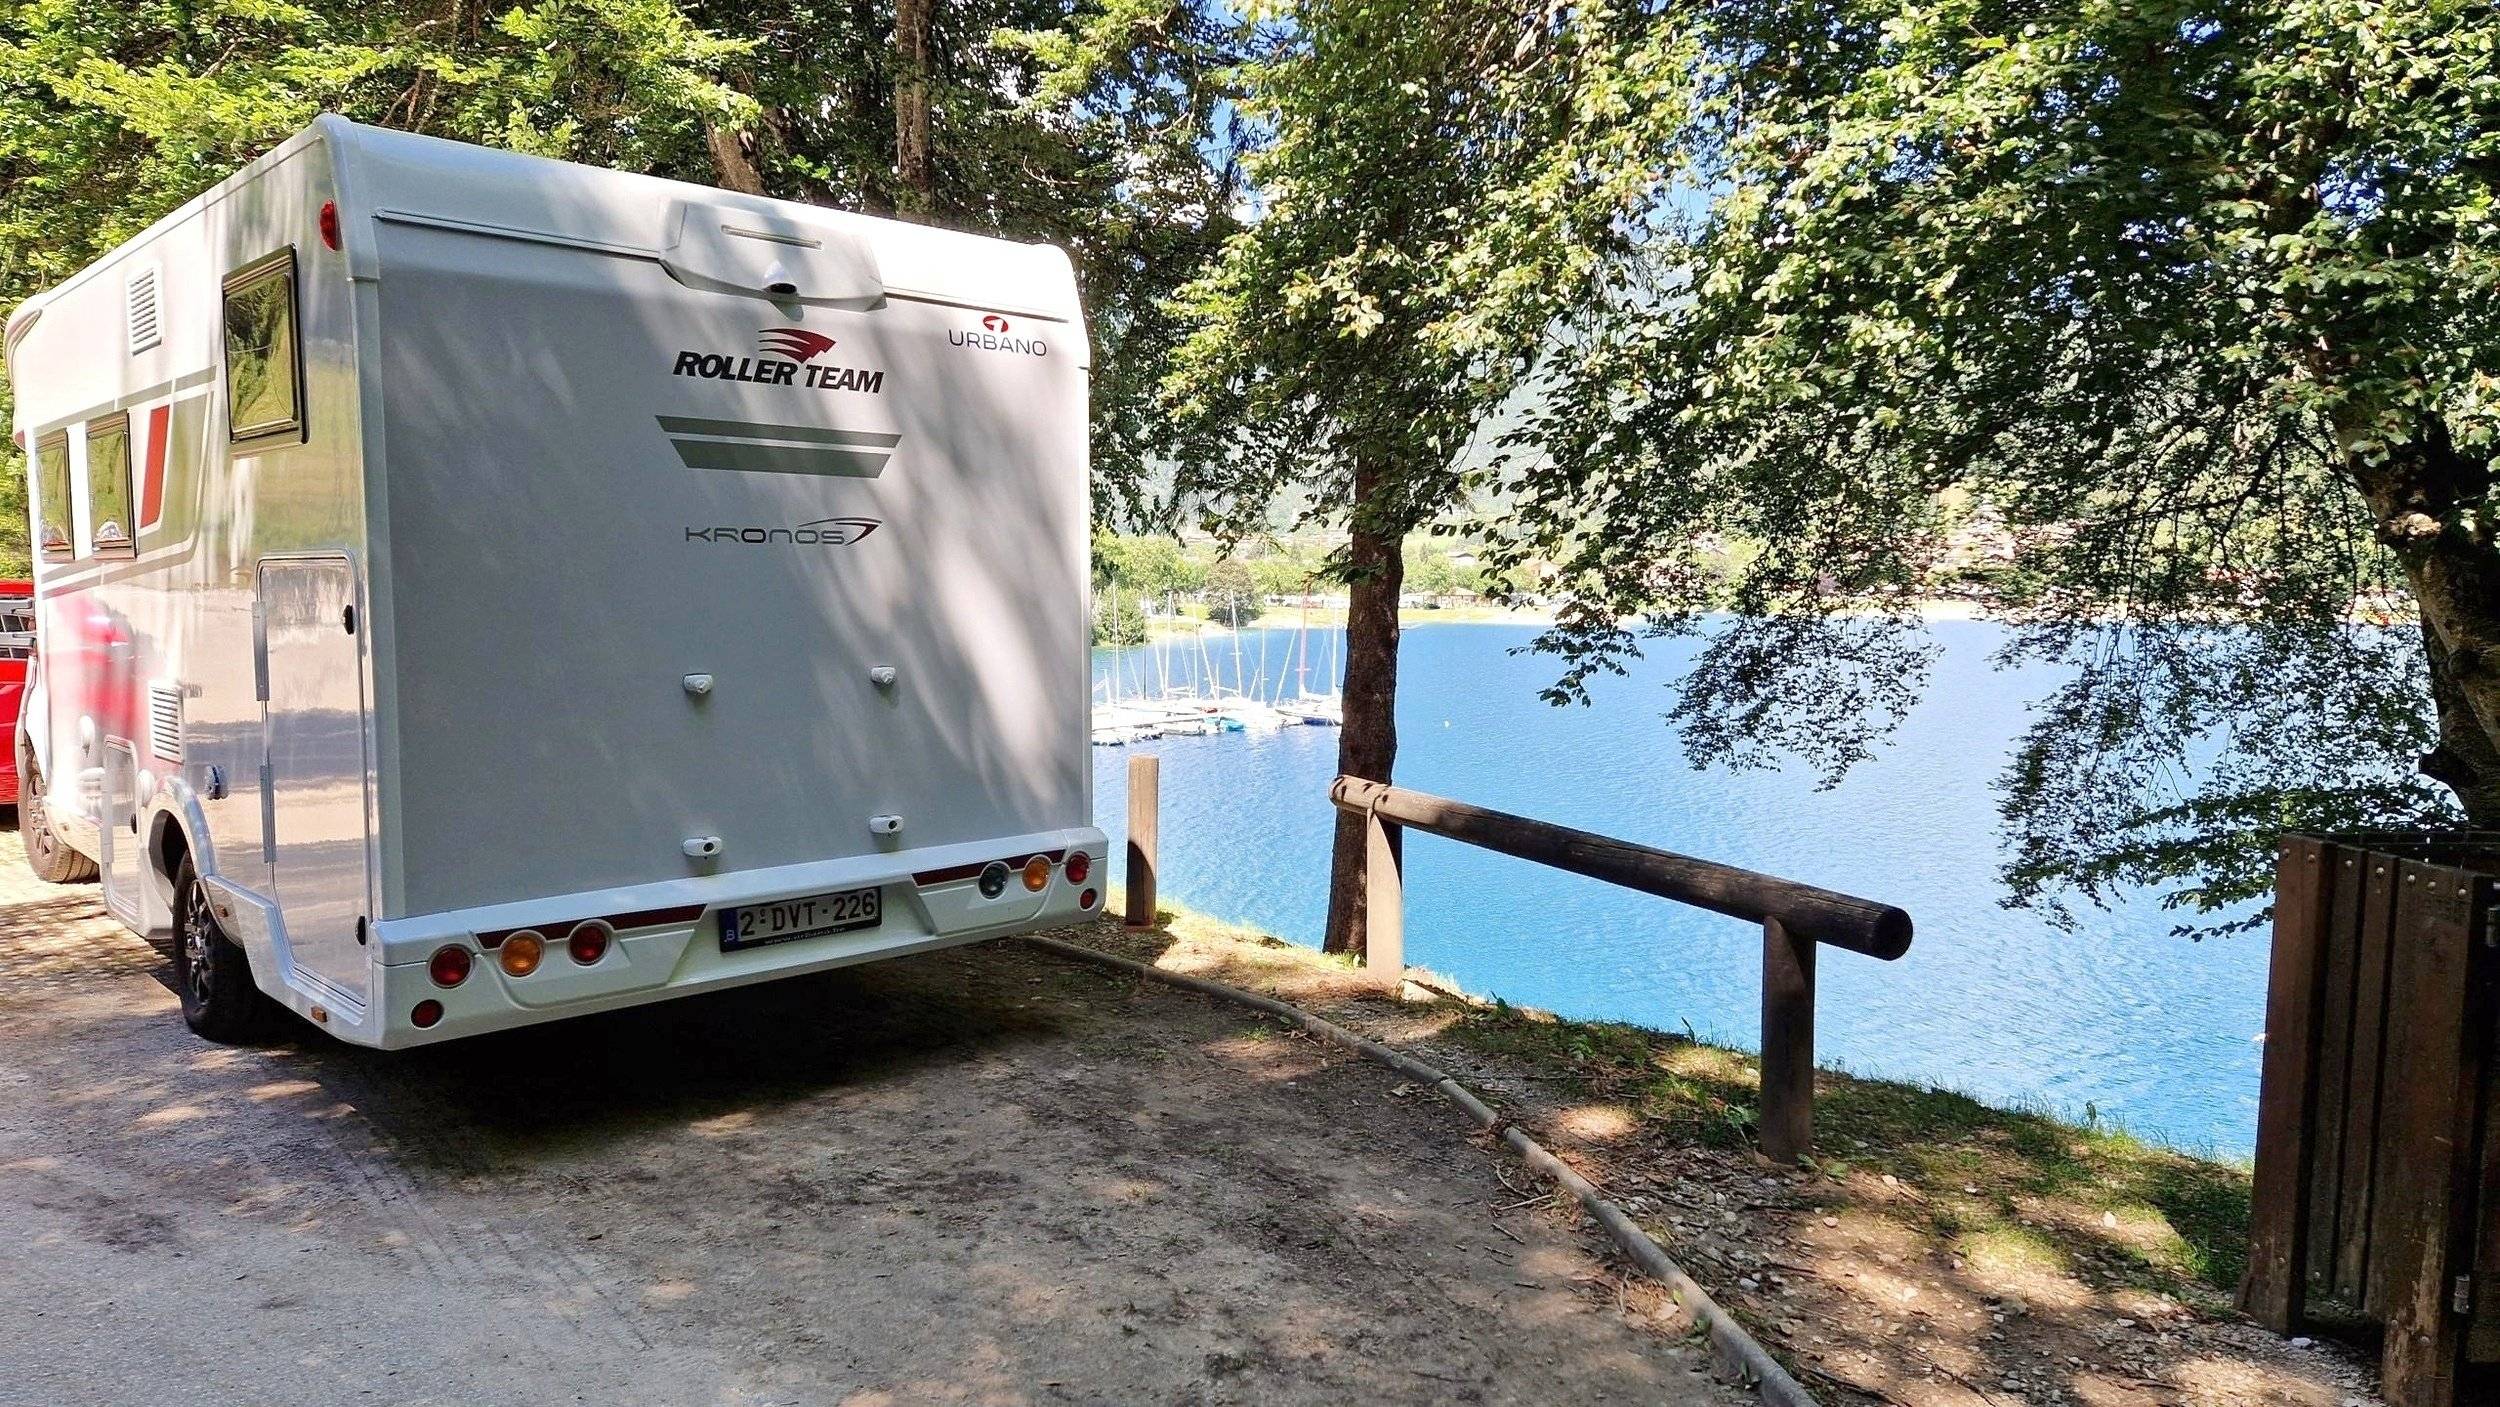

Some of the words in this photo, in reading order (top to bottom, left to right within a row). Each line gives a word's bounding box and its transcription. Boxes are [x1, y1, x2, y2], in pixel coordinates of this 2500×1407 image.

[948, 328, 1047, 357] URBANO
[672, 350, 799, 386] ROLLER
[804, 364, 885, 394] TEAM
